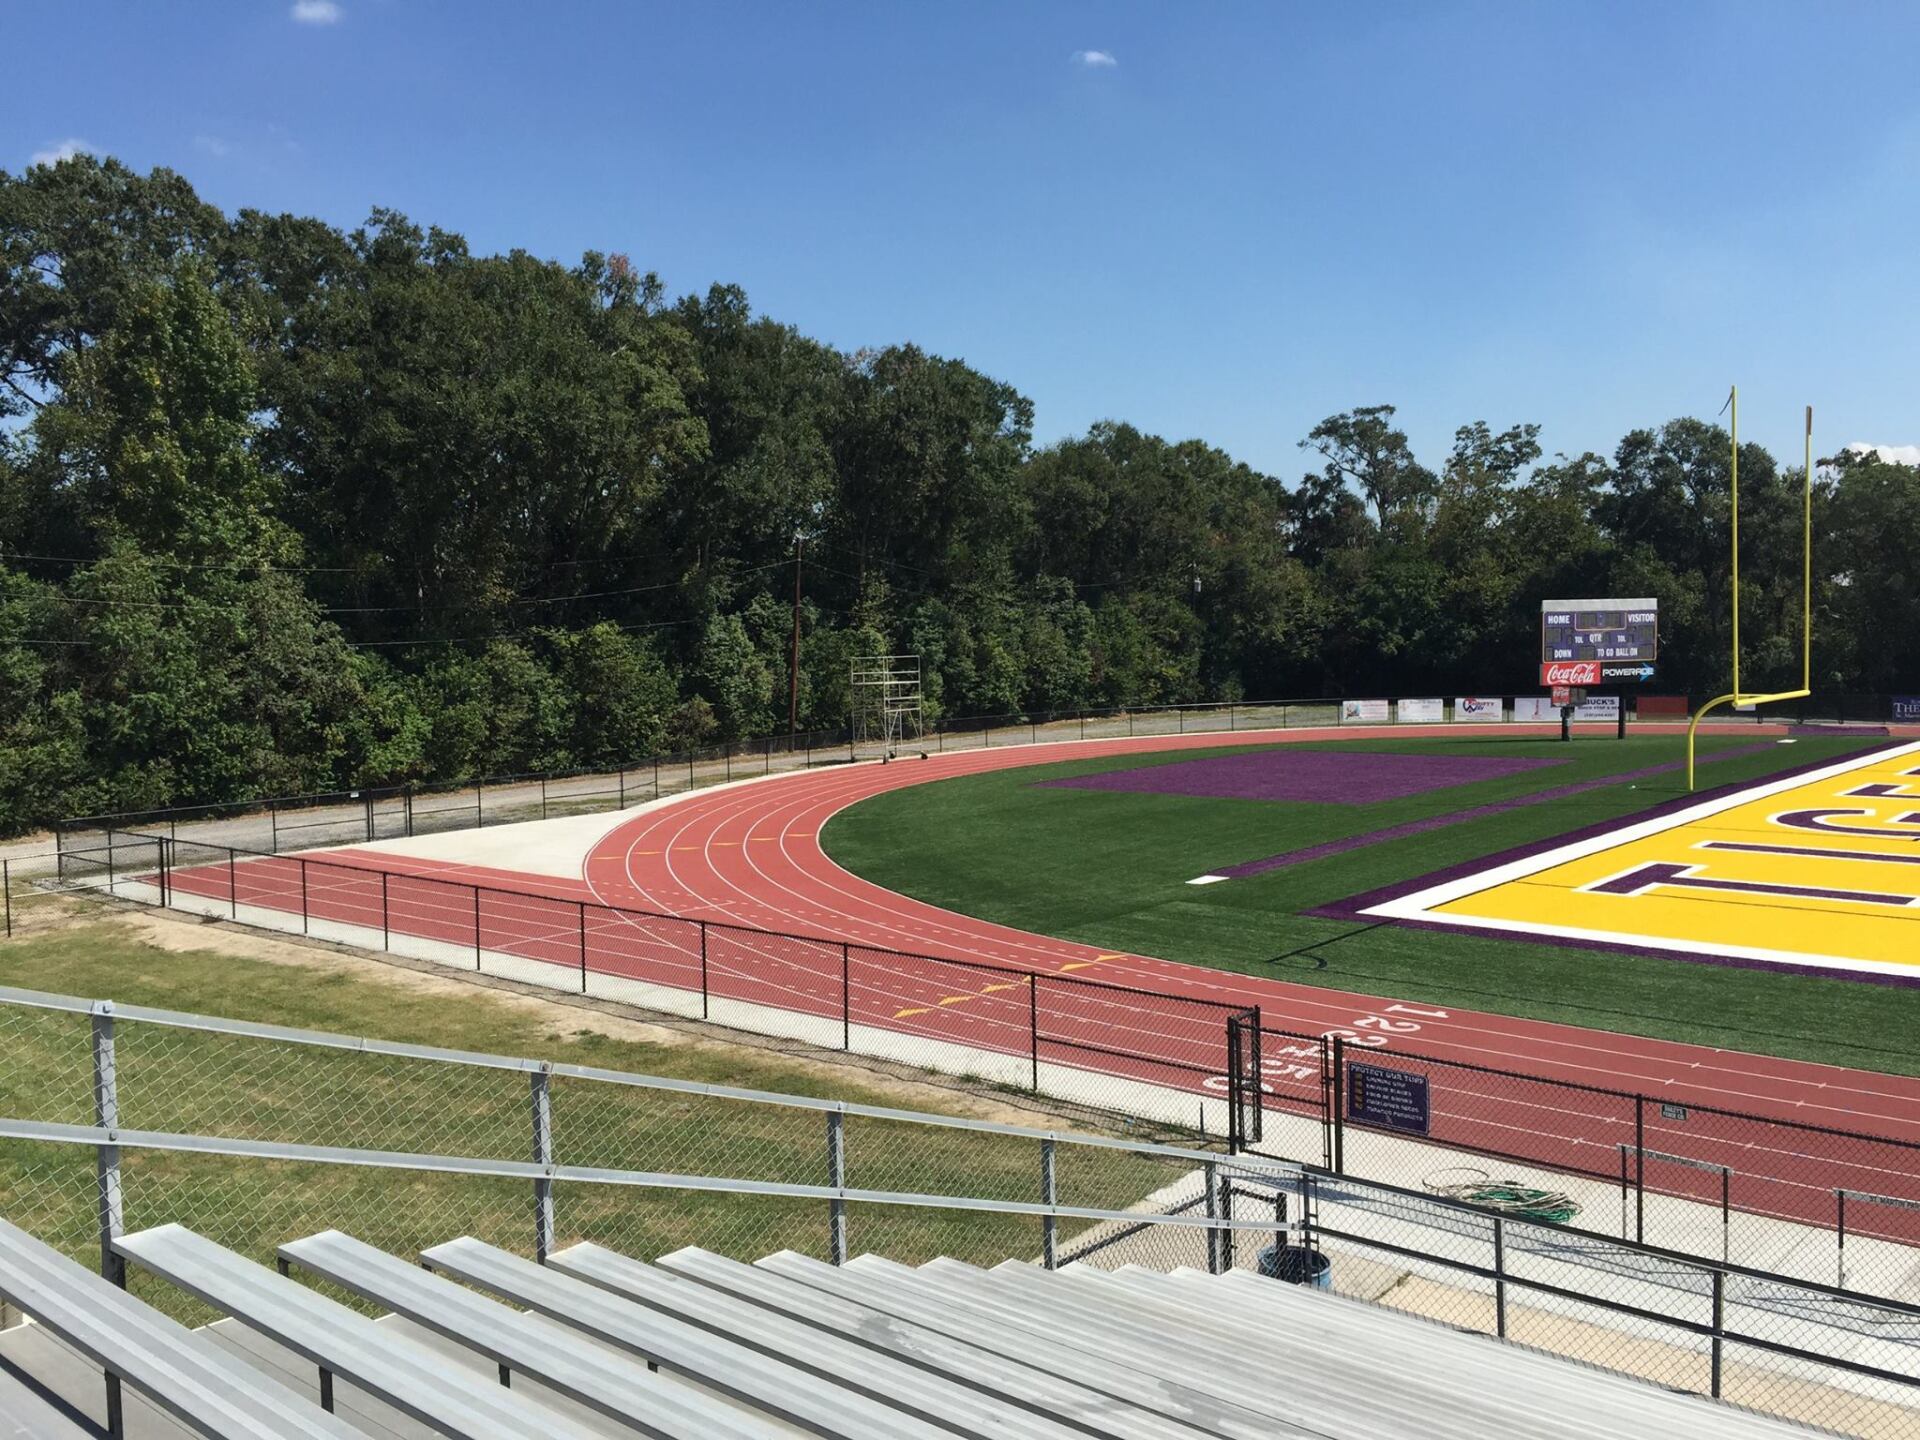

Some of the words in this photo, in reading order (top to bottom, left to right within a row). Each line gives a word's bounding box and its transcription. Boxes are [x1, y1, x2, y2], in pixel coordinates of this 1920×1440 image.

[1548, 615, 1571, 624] HOME
[1628, 613, 1655, 623] VISITOR
[1589, 634, 1602, 643] QTR
[1554, 650, 1572, 658] DOWN
[1597, 649, 1604, 657] TO
[1606, 649, 1614, 657] GO
[1615, 648, 1629, 656] BALL
[1629, 648, 1638, 656] ON
[1384, 1004, 1449, 1019] 1
[1353, 1015, 1422, 1033] 2
